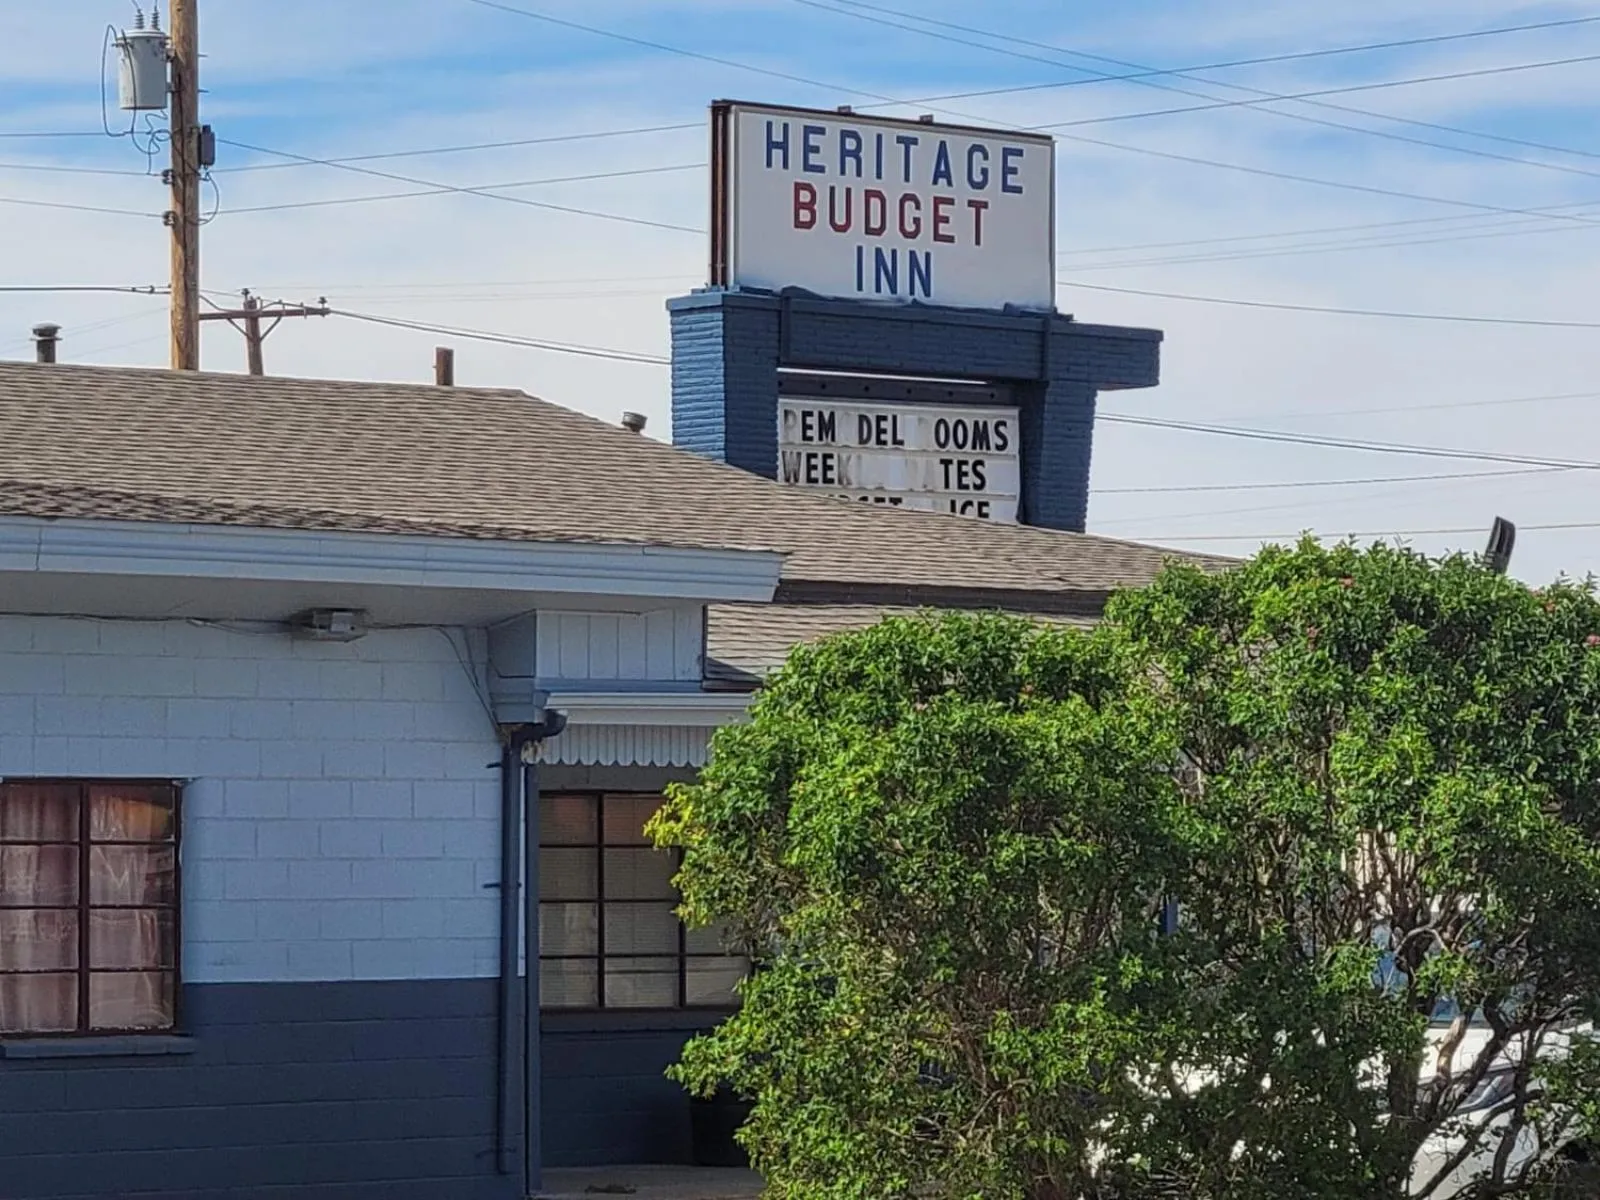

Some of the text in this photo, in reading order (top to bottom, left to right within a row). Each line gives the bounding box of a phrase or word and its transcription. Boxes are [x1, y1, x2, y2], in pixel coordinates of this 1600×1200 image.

[766, 120, 1024, 195] HERITAGE
[793, 181, 990, 247] BUDGET
[855, 245, 932, 298] INN
[934, 418, 1009, 451] OOMS
[939, 458, 986, 491] TES
